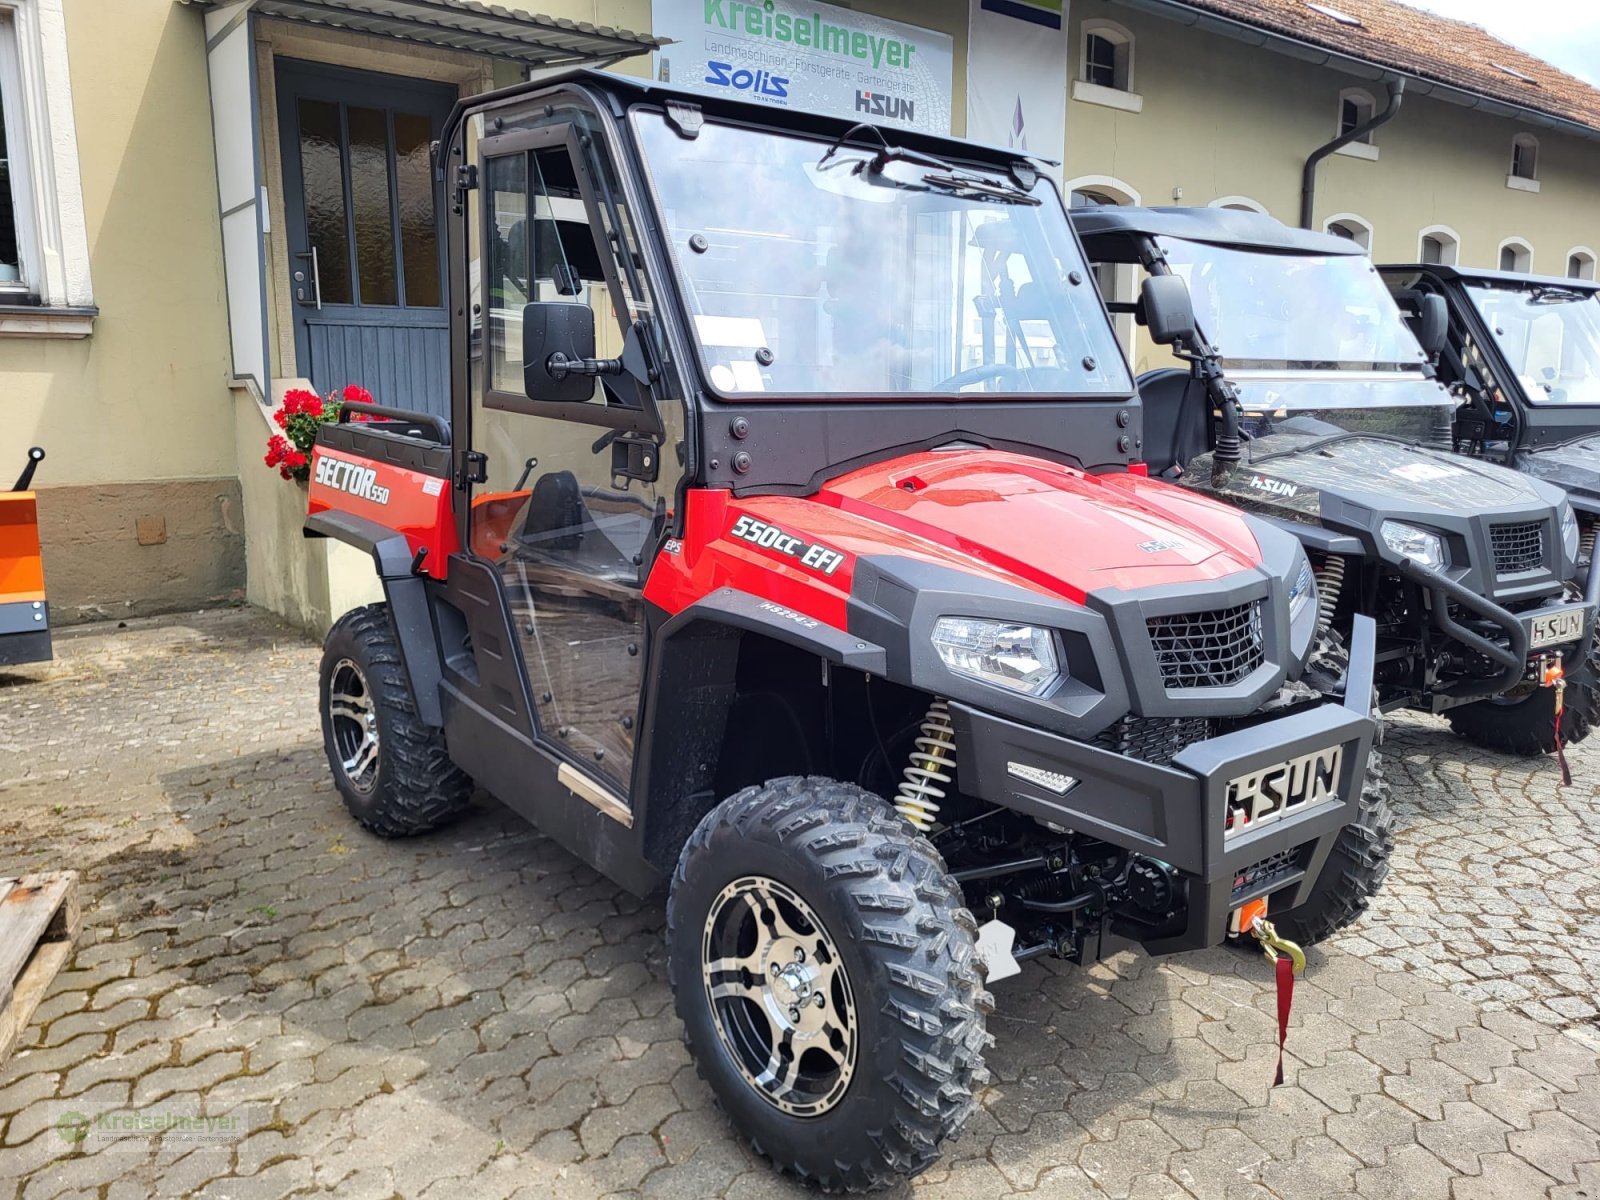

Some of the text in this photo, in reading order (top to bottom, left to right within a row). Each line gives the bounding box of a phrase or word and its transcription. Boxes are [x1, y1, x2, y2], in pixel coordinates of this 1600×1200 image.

[704, 0, 915, 69] Kreiselmeyer
[705, 38, 915, 93] Landmaschinen Forstgeräte Gartengeräte
[315, 456, 376, 499] SECTOR
[370, 484, 389, 504] 550
[664, 539, 682, 553] EPS
[731, 515, 844, 574] 550cc EFI
